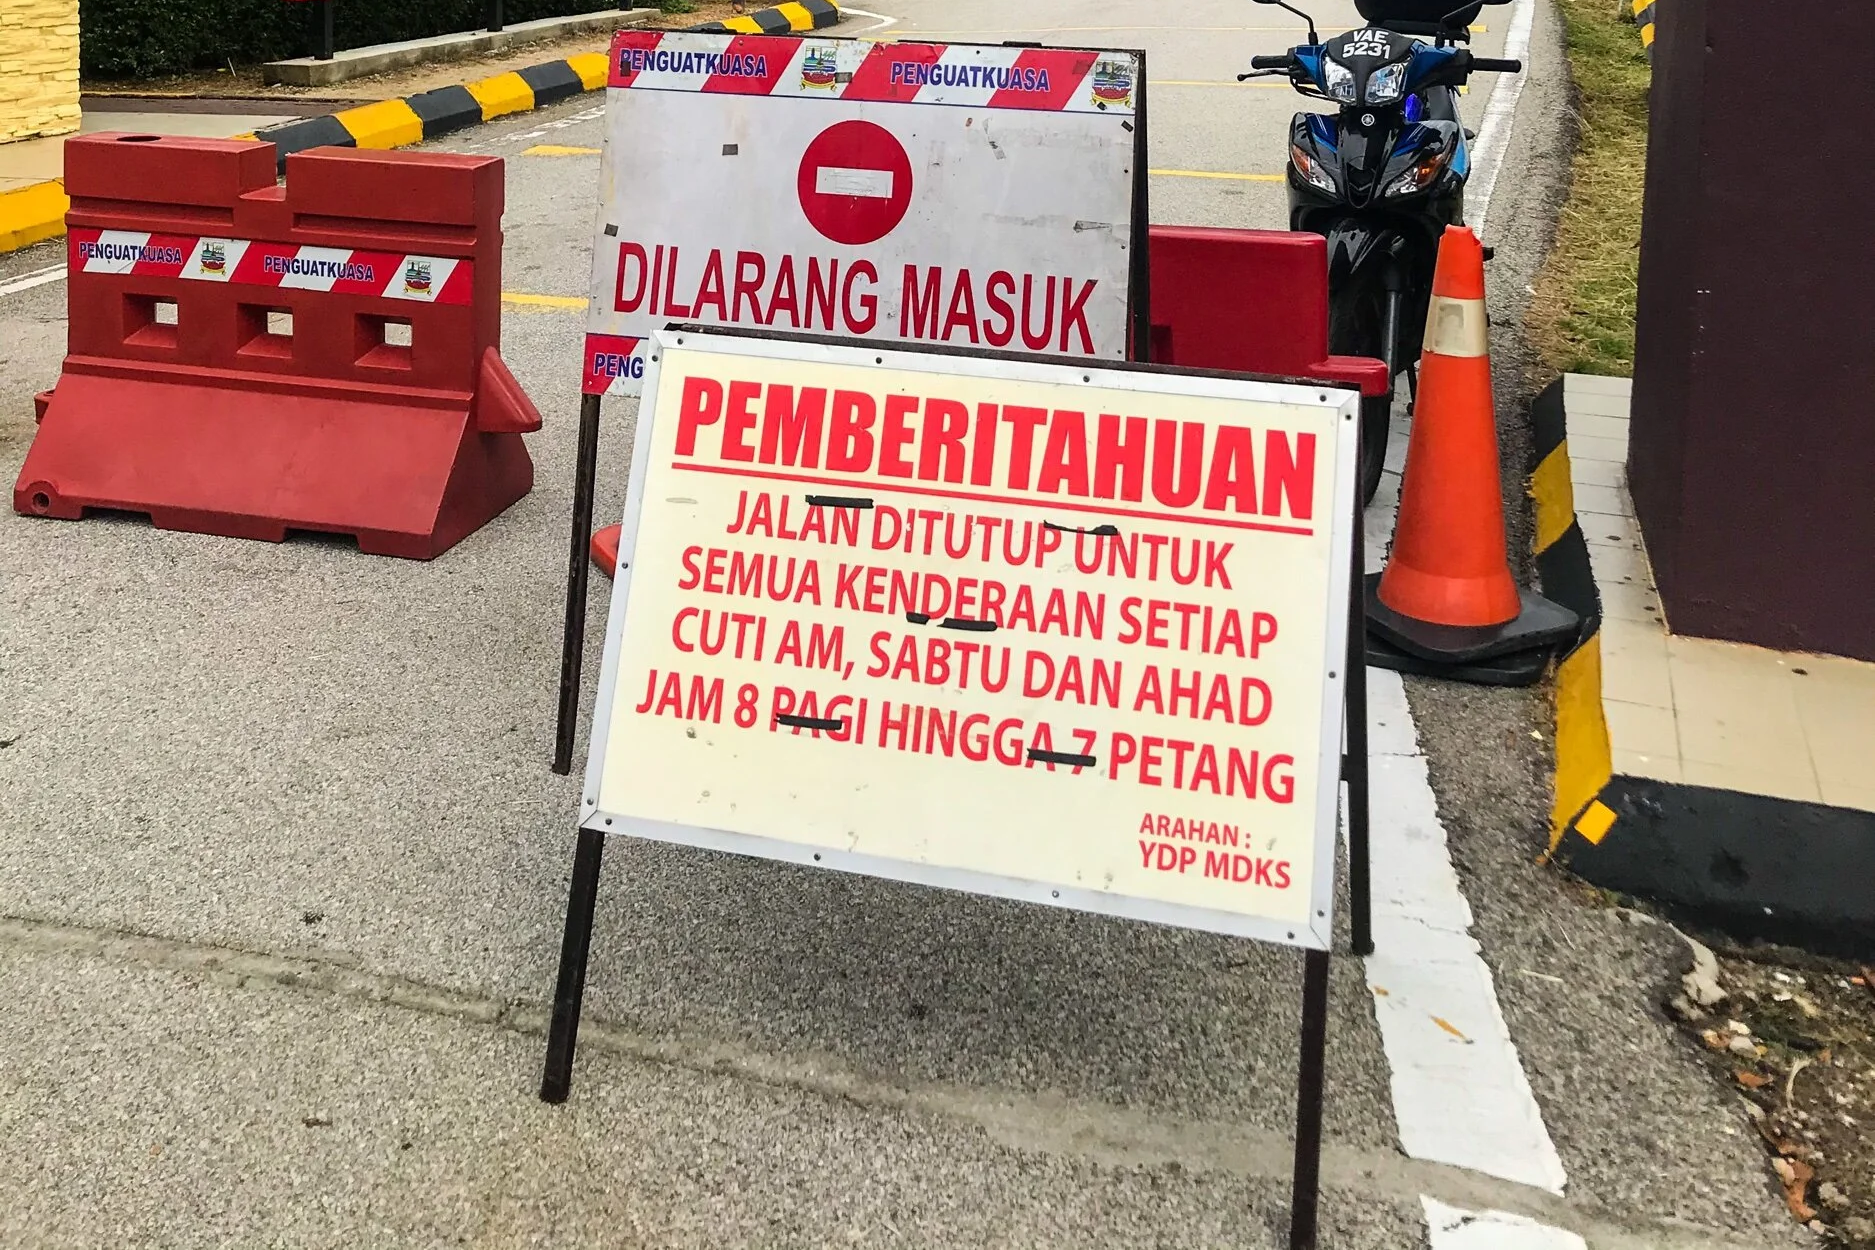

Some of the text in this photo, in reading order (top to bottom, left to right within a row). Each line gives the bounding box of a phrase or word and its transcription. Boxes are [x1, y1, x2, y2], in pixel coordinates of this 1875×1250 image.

[1342, 42, 1391, 60] 5231
[1352, 30, 1389, 44] VAE
[619, 47, 768, 79] PENGUATKUASA
[889, 60, 1051, 92] PENGUATKUASA
[78, 241, 182, 265] PENGUATKUASA
[263, 254, 375, 282] PENGUATKUASA
[613, 241, 1098, 355] DILARANG MASUK
[674, 376, 1317, 521] PEMBERITAHUAN
[726, 490, 1234, 590] JALAN DITUTUP UNTUK
[678, 545, 1278, 659] SEMUA KENDERAAN SETIAP
[672, 606, 1273, 727] CUTI AM, SABTU DAN AHAD
[635, 669, 1295, 804] JAM 8 PAGI HINGGA 7 PETANG
[1139, 840, 1291, 889] YDP MDKS
